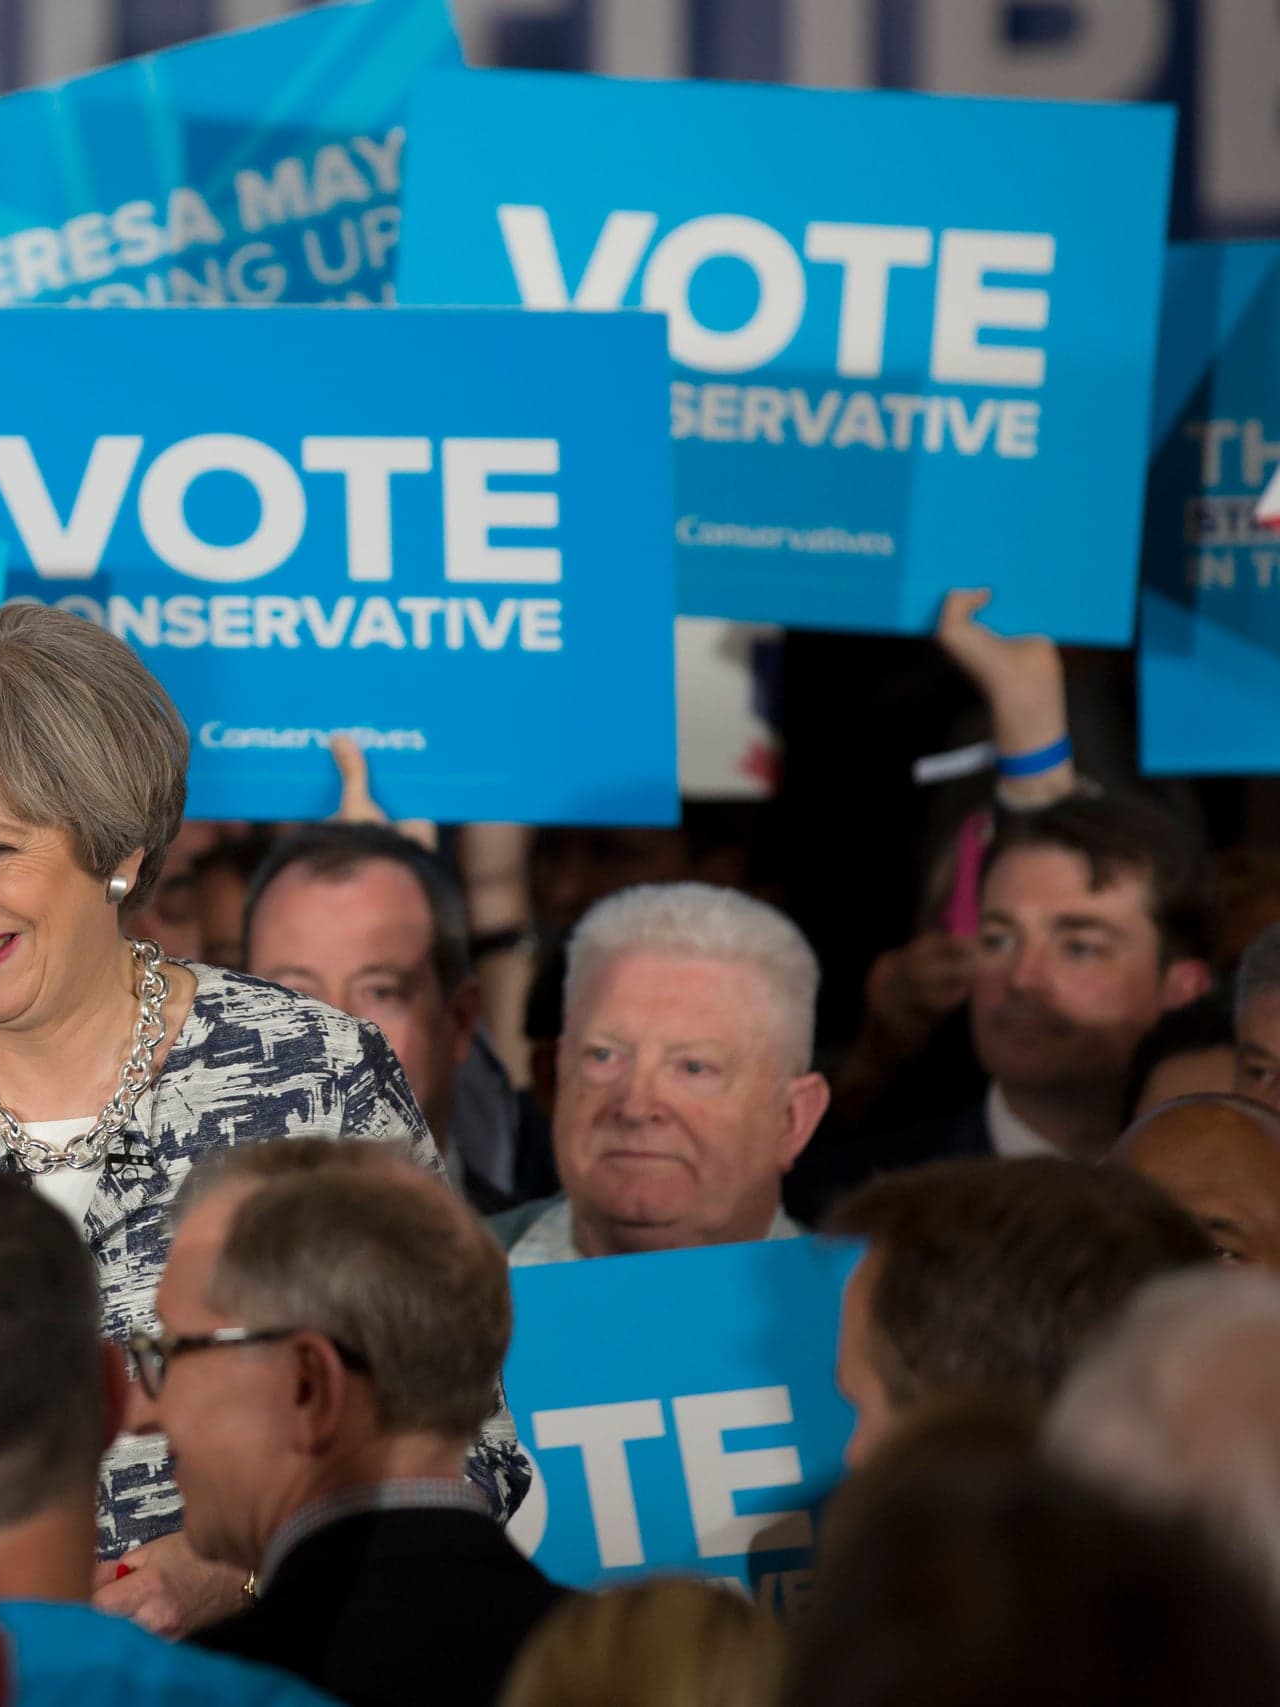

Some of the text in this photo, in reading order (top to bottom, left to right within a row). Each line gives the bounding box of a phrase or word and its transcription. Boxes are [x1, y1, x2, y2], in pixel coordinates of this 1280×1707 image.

[234, 126, 407, 233] MAY
[497, 203, 1057, 389] VOTE
[4, 594, 564, 652] NSERVATIVE
